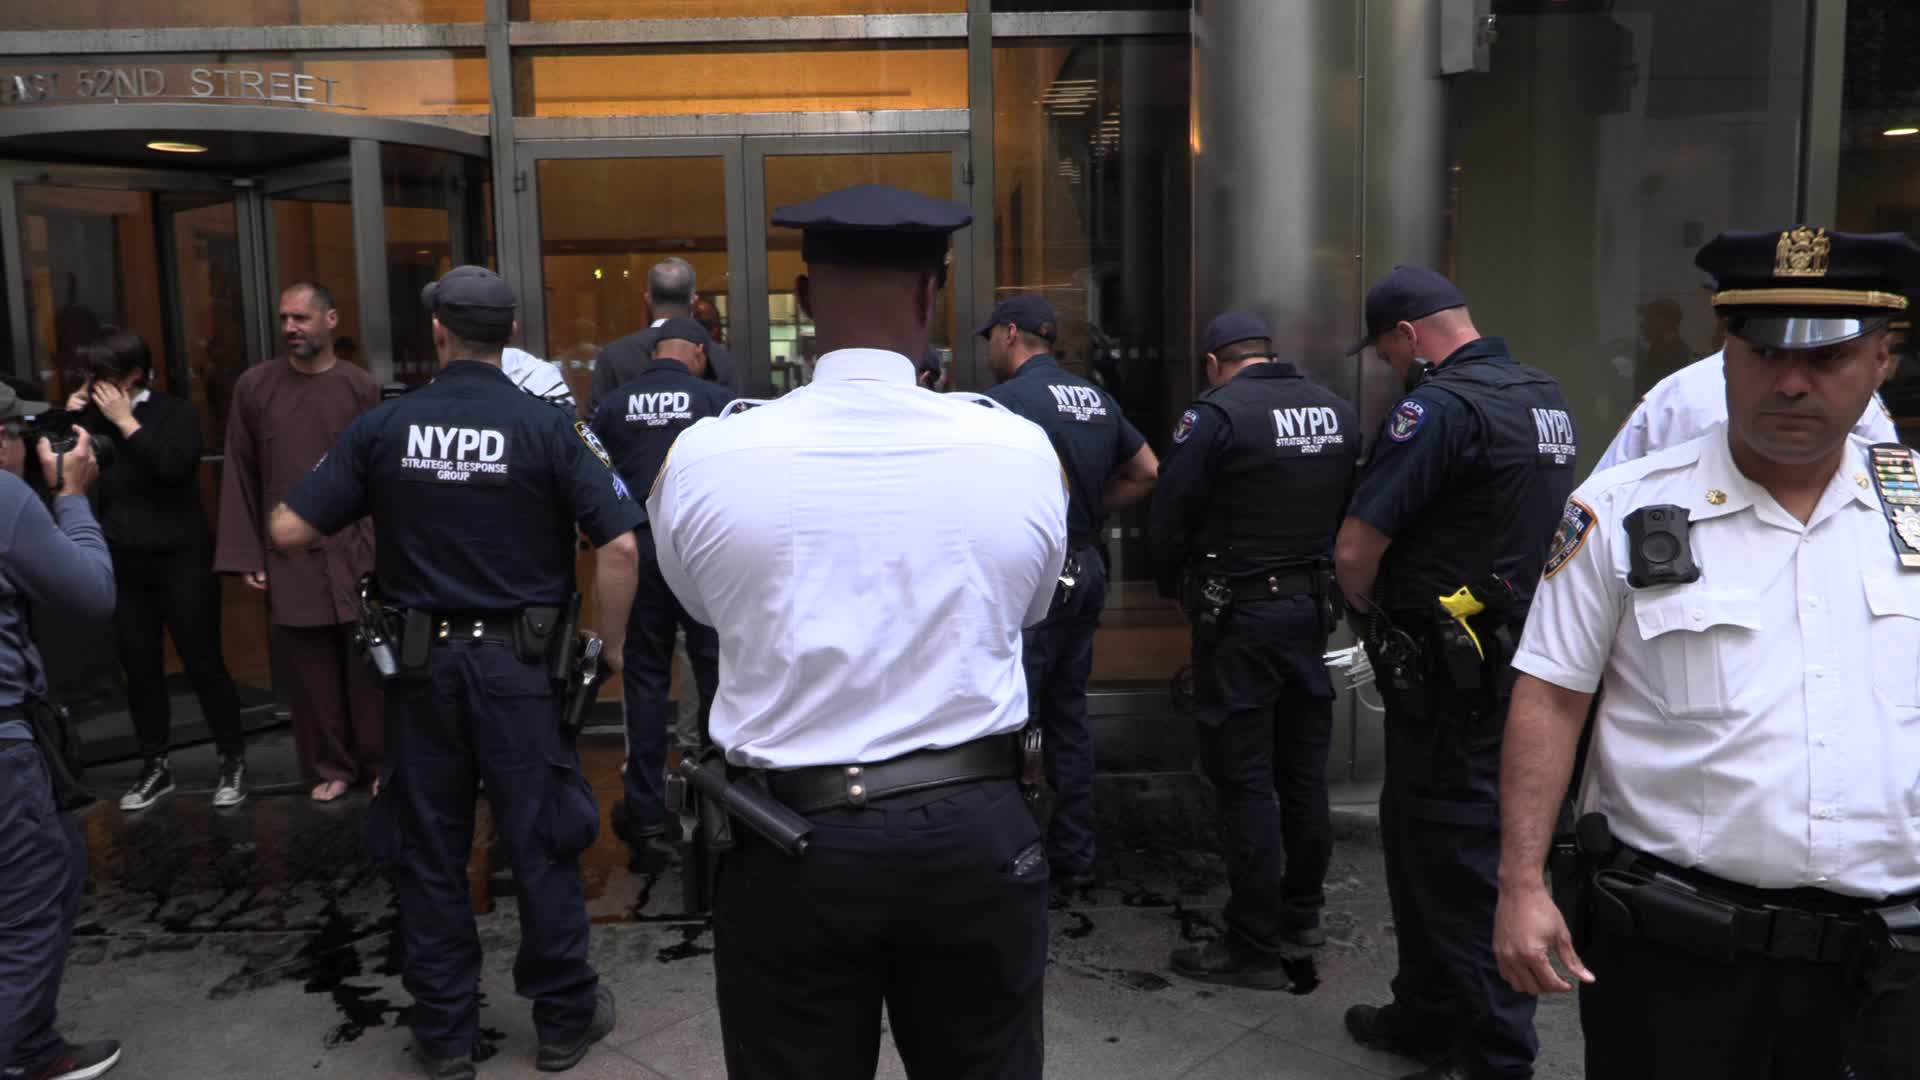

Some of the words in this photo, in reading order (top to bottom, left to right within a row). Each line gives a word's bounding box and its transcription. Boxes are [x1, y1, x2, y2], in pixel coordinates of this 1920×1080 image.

[78, 68, 166, 97] 52ND
[191, 68, 340, 105] STREET
[628, 392, 689, 414] NYPD
[1047, 384, 1101, 408] NYPD
[1273, 407, 1338, 437] NYPD
[1531, 407, 1573, 443] NYPD
[407, 424, 505, 462] NYPD
[401, 458, 454, 470] STRATEGIC
[456, 461, 508, 473] RESPONSE
[437, 470, 471, 481] GROUP
